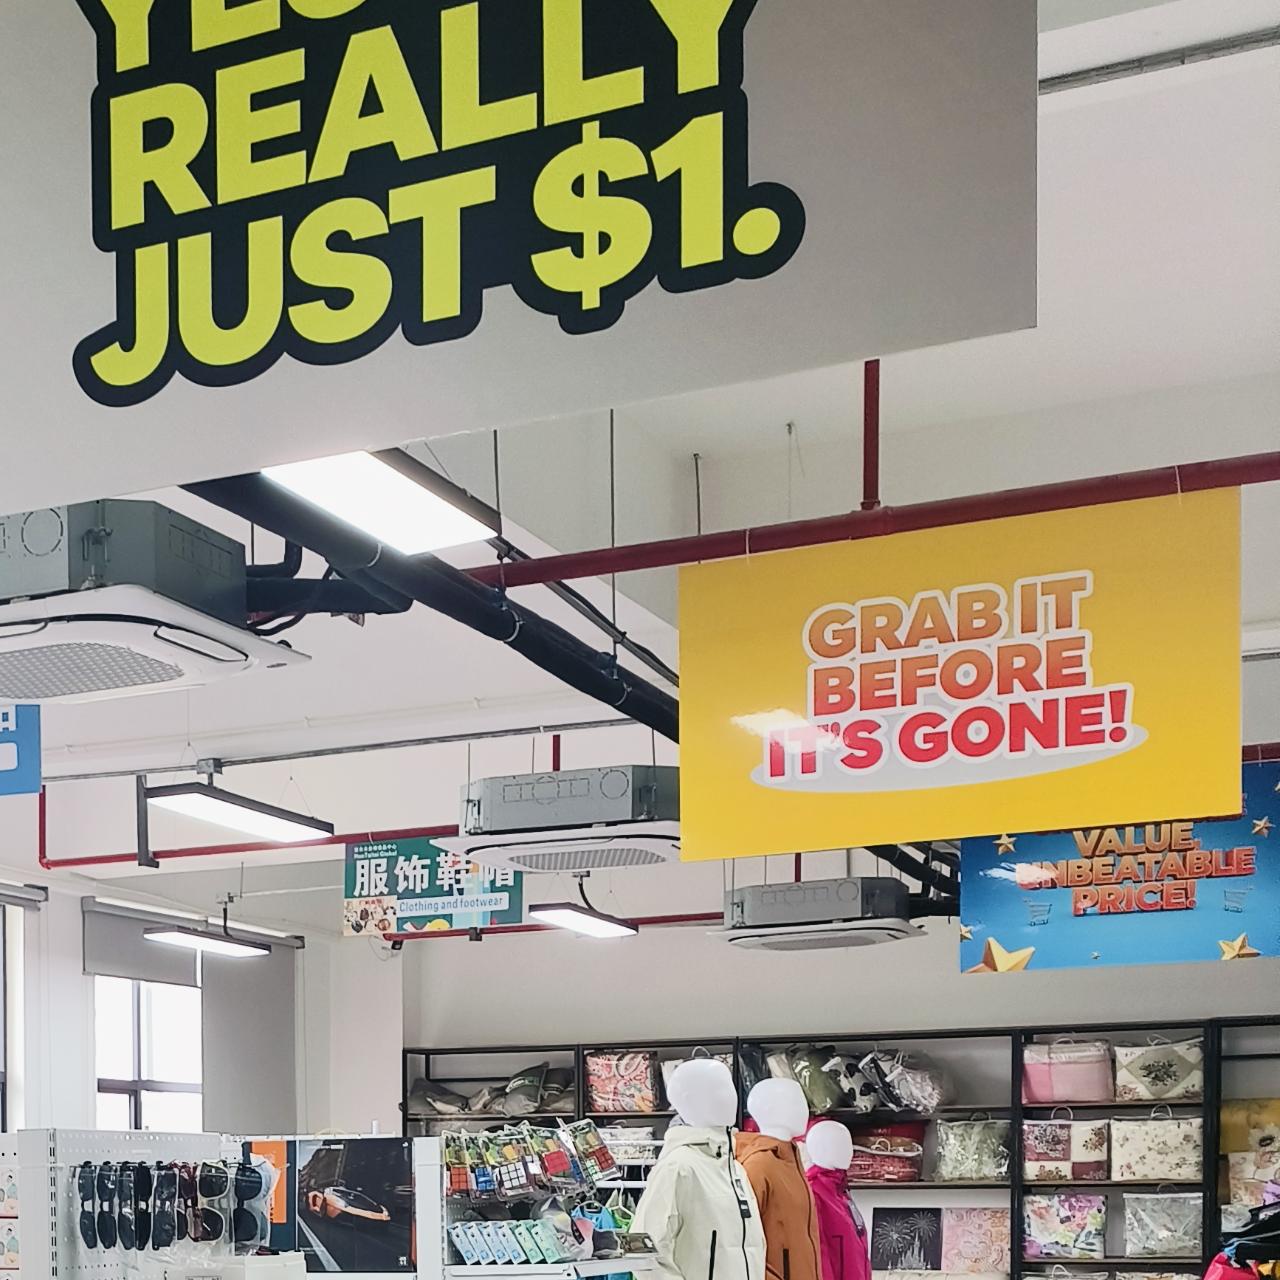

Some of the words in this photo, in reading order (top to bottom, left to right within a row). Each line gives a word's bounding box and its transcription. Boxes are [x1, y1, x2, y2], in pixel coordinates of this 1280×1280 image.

[110, 0, 744, 231] REALLY
[90, 165, 496, 386] JUST
[531, 112, 781, 310] $1.
[808, 588, 1003, 658] GRAB
[1020, 576, 1088, 634] IT
[813, 636, 1087, 716] BEFORE
[768, 718, 884, 777] IT'S
[898, 690, 1129, 763] GONE!
[353, 852, 515, 897] 服饰鞋帽
[399, 900, 439, 914] Clothing
[441, 898, 458, 910] and
[459, 896, 504, 909] footwear
[1072, 879, 1198, 917] PRICE!
